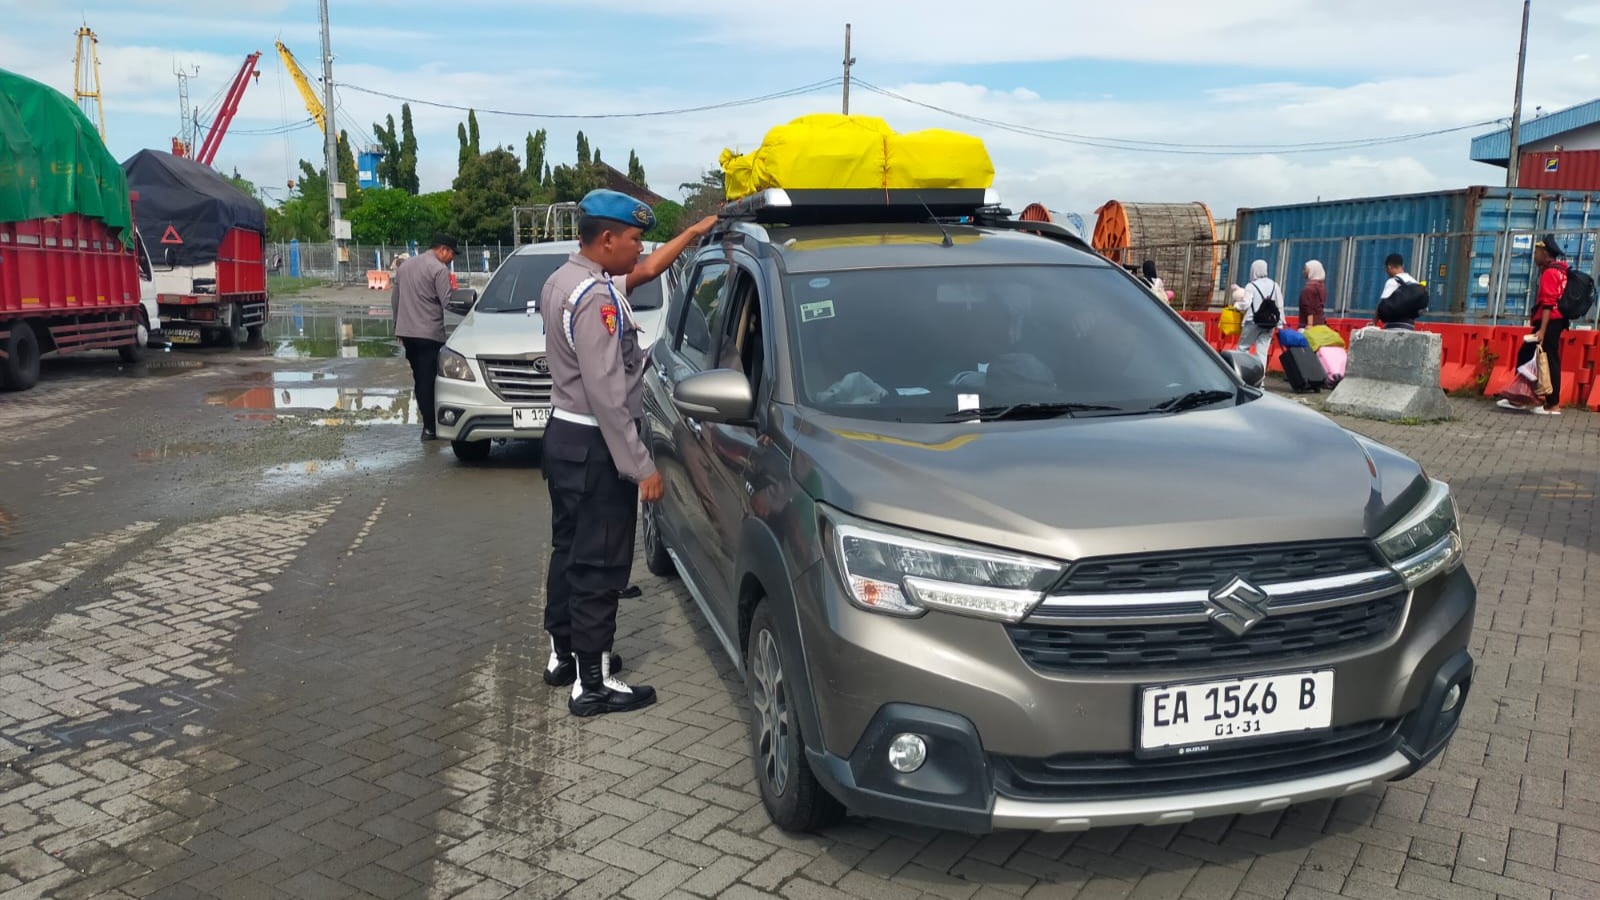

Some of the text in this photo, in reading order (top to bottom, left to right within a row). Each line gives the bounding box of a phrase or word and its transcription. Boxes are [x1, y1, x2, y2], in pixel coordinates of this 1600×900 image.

[515, 409, 522, 420] N
[1153, 677, 1316, 727] EA 1546 B
